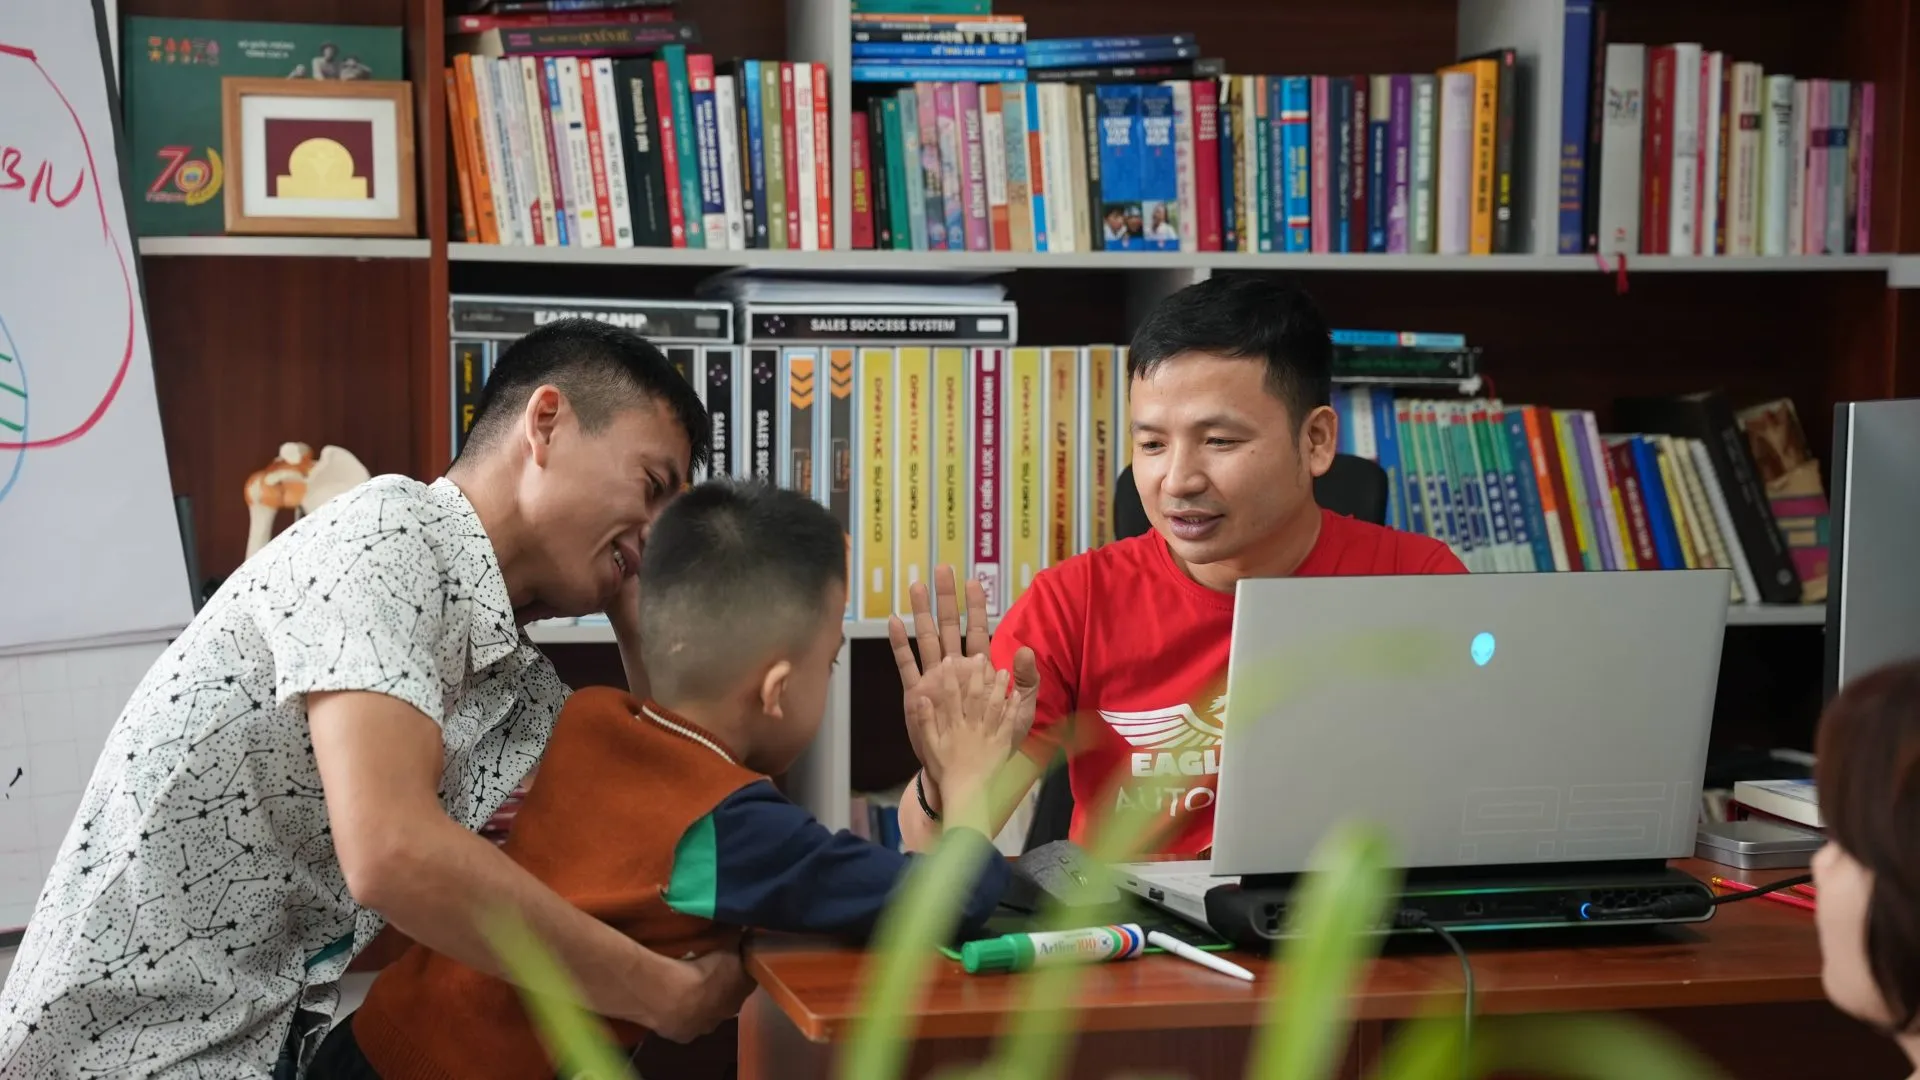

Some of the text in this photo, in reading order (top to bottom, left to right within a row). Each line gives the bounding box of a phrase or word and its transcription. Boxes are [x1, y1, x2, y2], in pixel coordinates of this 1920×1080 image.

[811, 318, 956, 332] SALES SUCCESS SYSTEM
[756, 409, 770, 448] SALES
[712, 412, 726, 483] SALES SUC
[1131, 749, 1219, 777] EAGL
